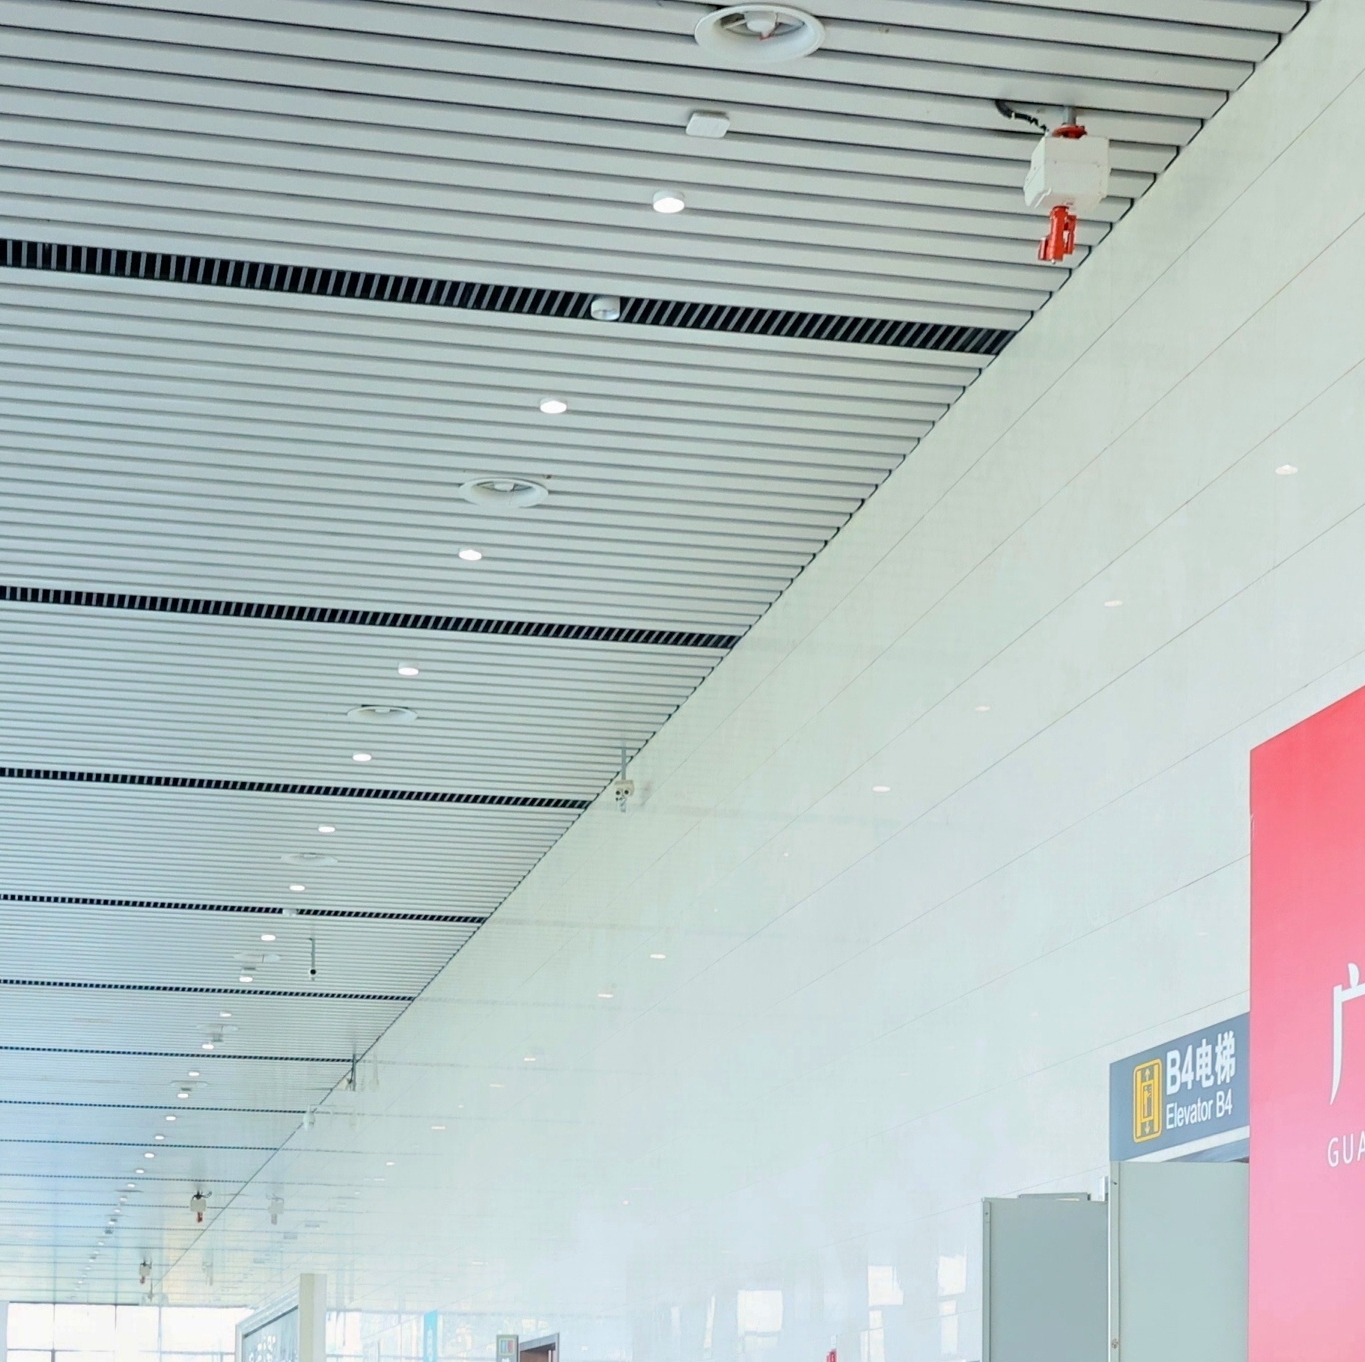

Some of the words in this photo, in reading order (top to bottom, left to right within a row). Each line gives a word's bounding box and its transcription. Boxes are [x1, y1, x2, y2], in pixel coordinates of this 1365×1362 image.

[1166, 1030, 1236, 1095] B4电梯
[1166, 1098, 1212, 1129] Elevator
[1216, 1088, 1233, 1118] B4
